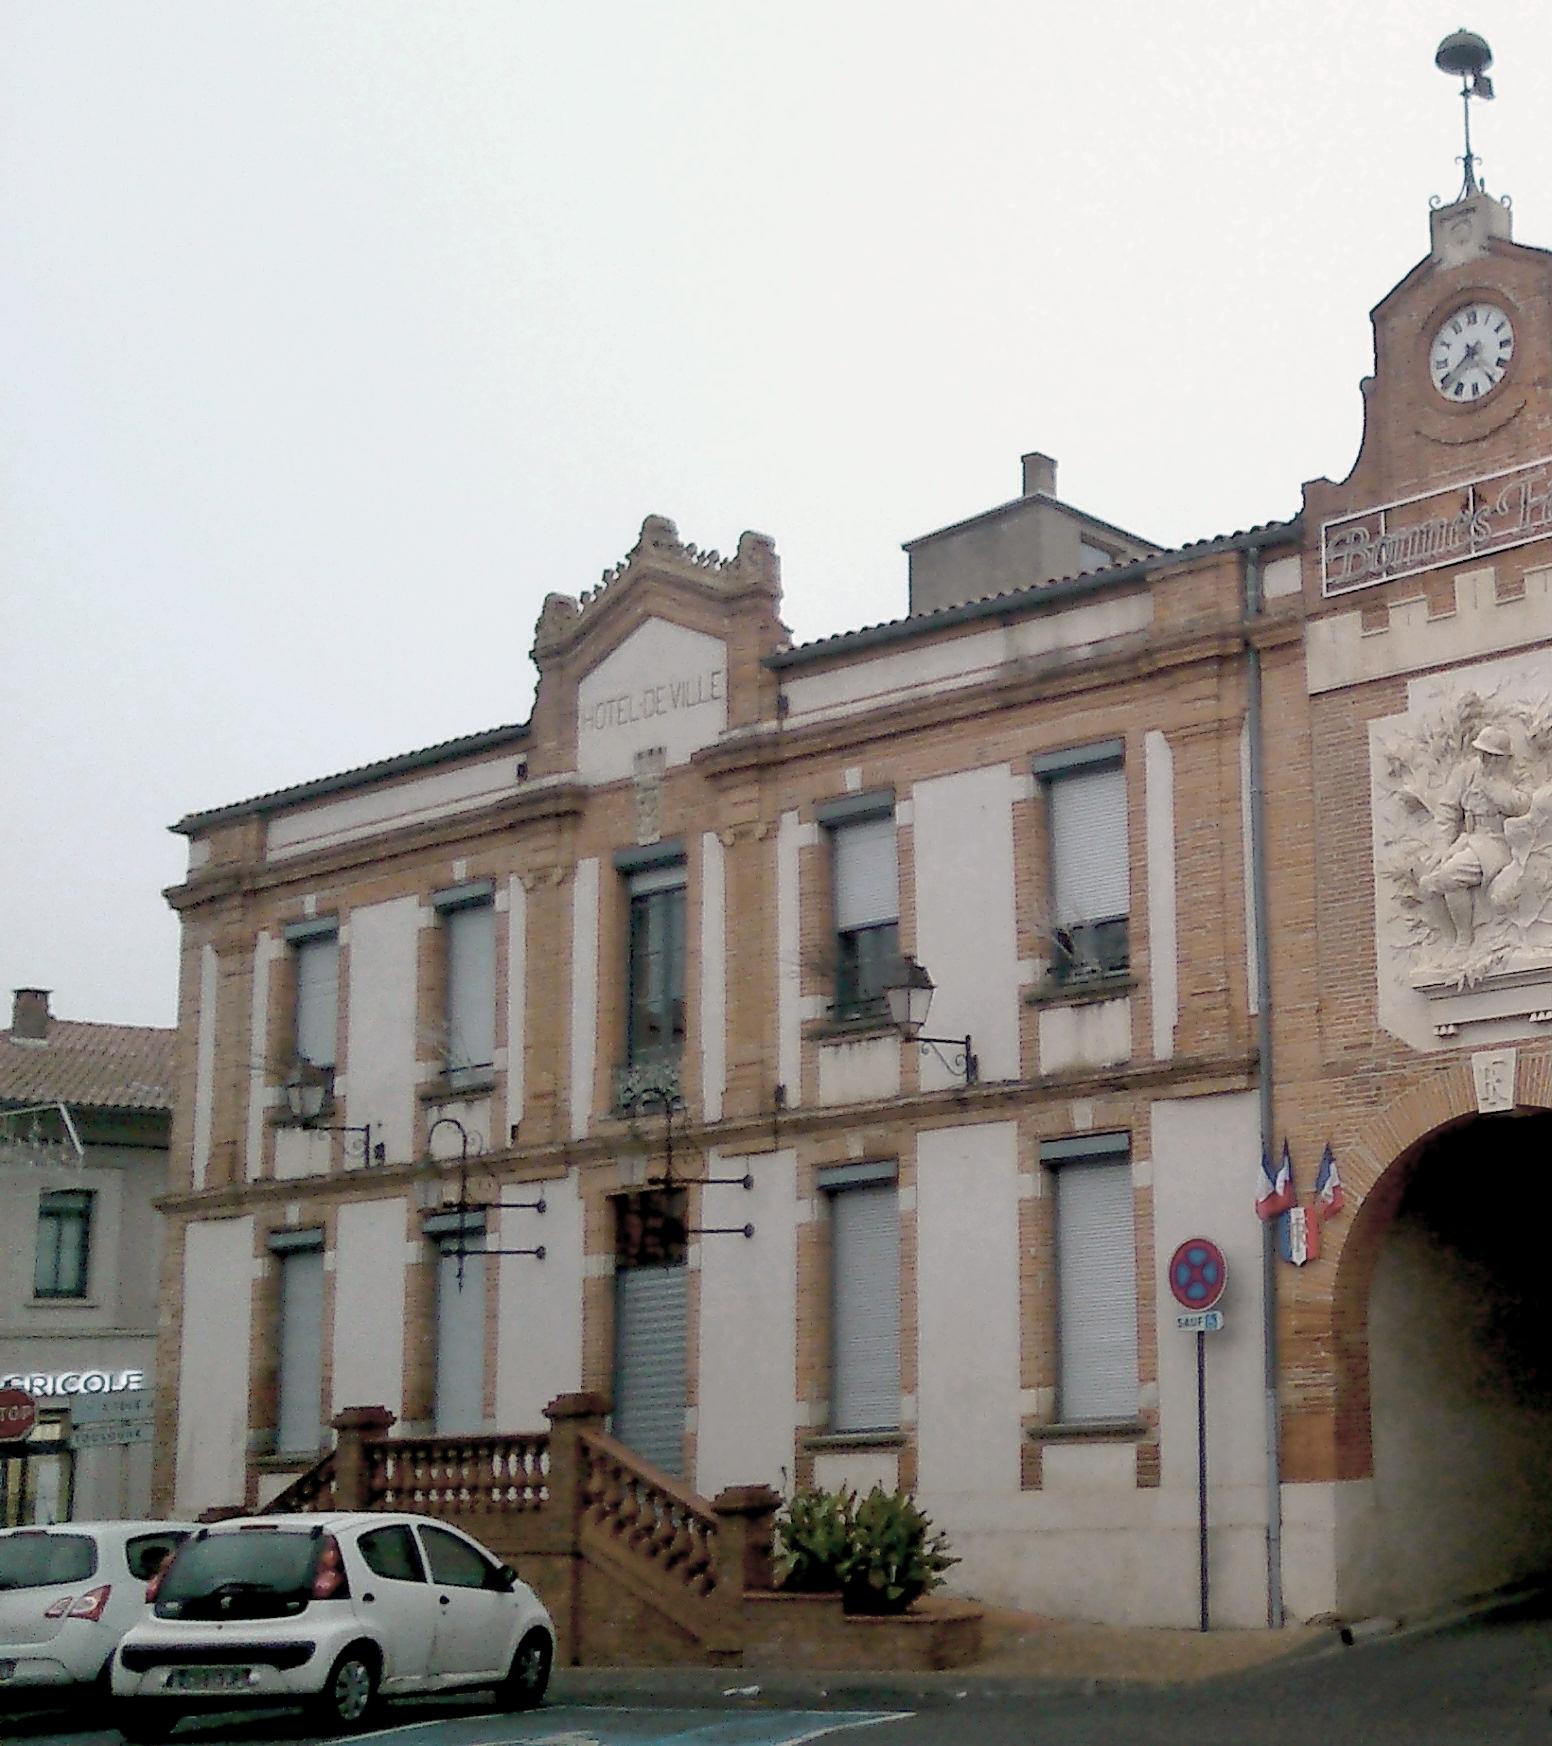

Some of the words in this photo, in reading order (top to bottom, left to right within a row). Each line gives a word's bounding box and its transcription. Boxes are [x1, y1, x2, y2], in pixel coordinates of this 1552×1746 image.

[643, 685, 667, 718] DE
[669, 670, 723, 709] VILLE
[0, 1369, 144, 1397] GRICOLE
[0, 1405, 34, 1422] TOP
